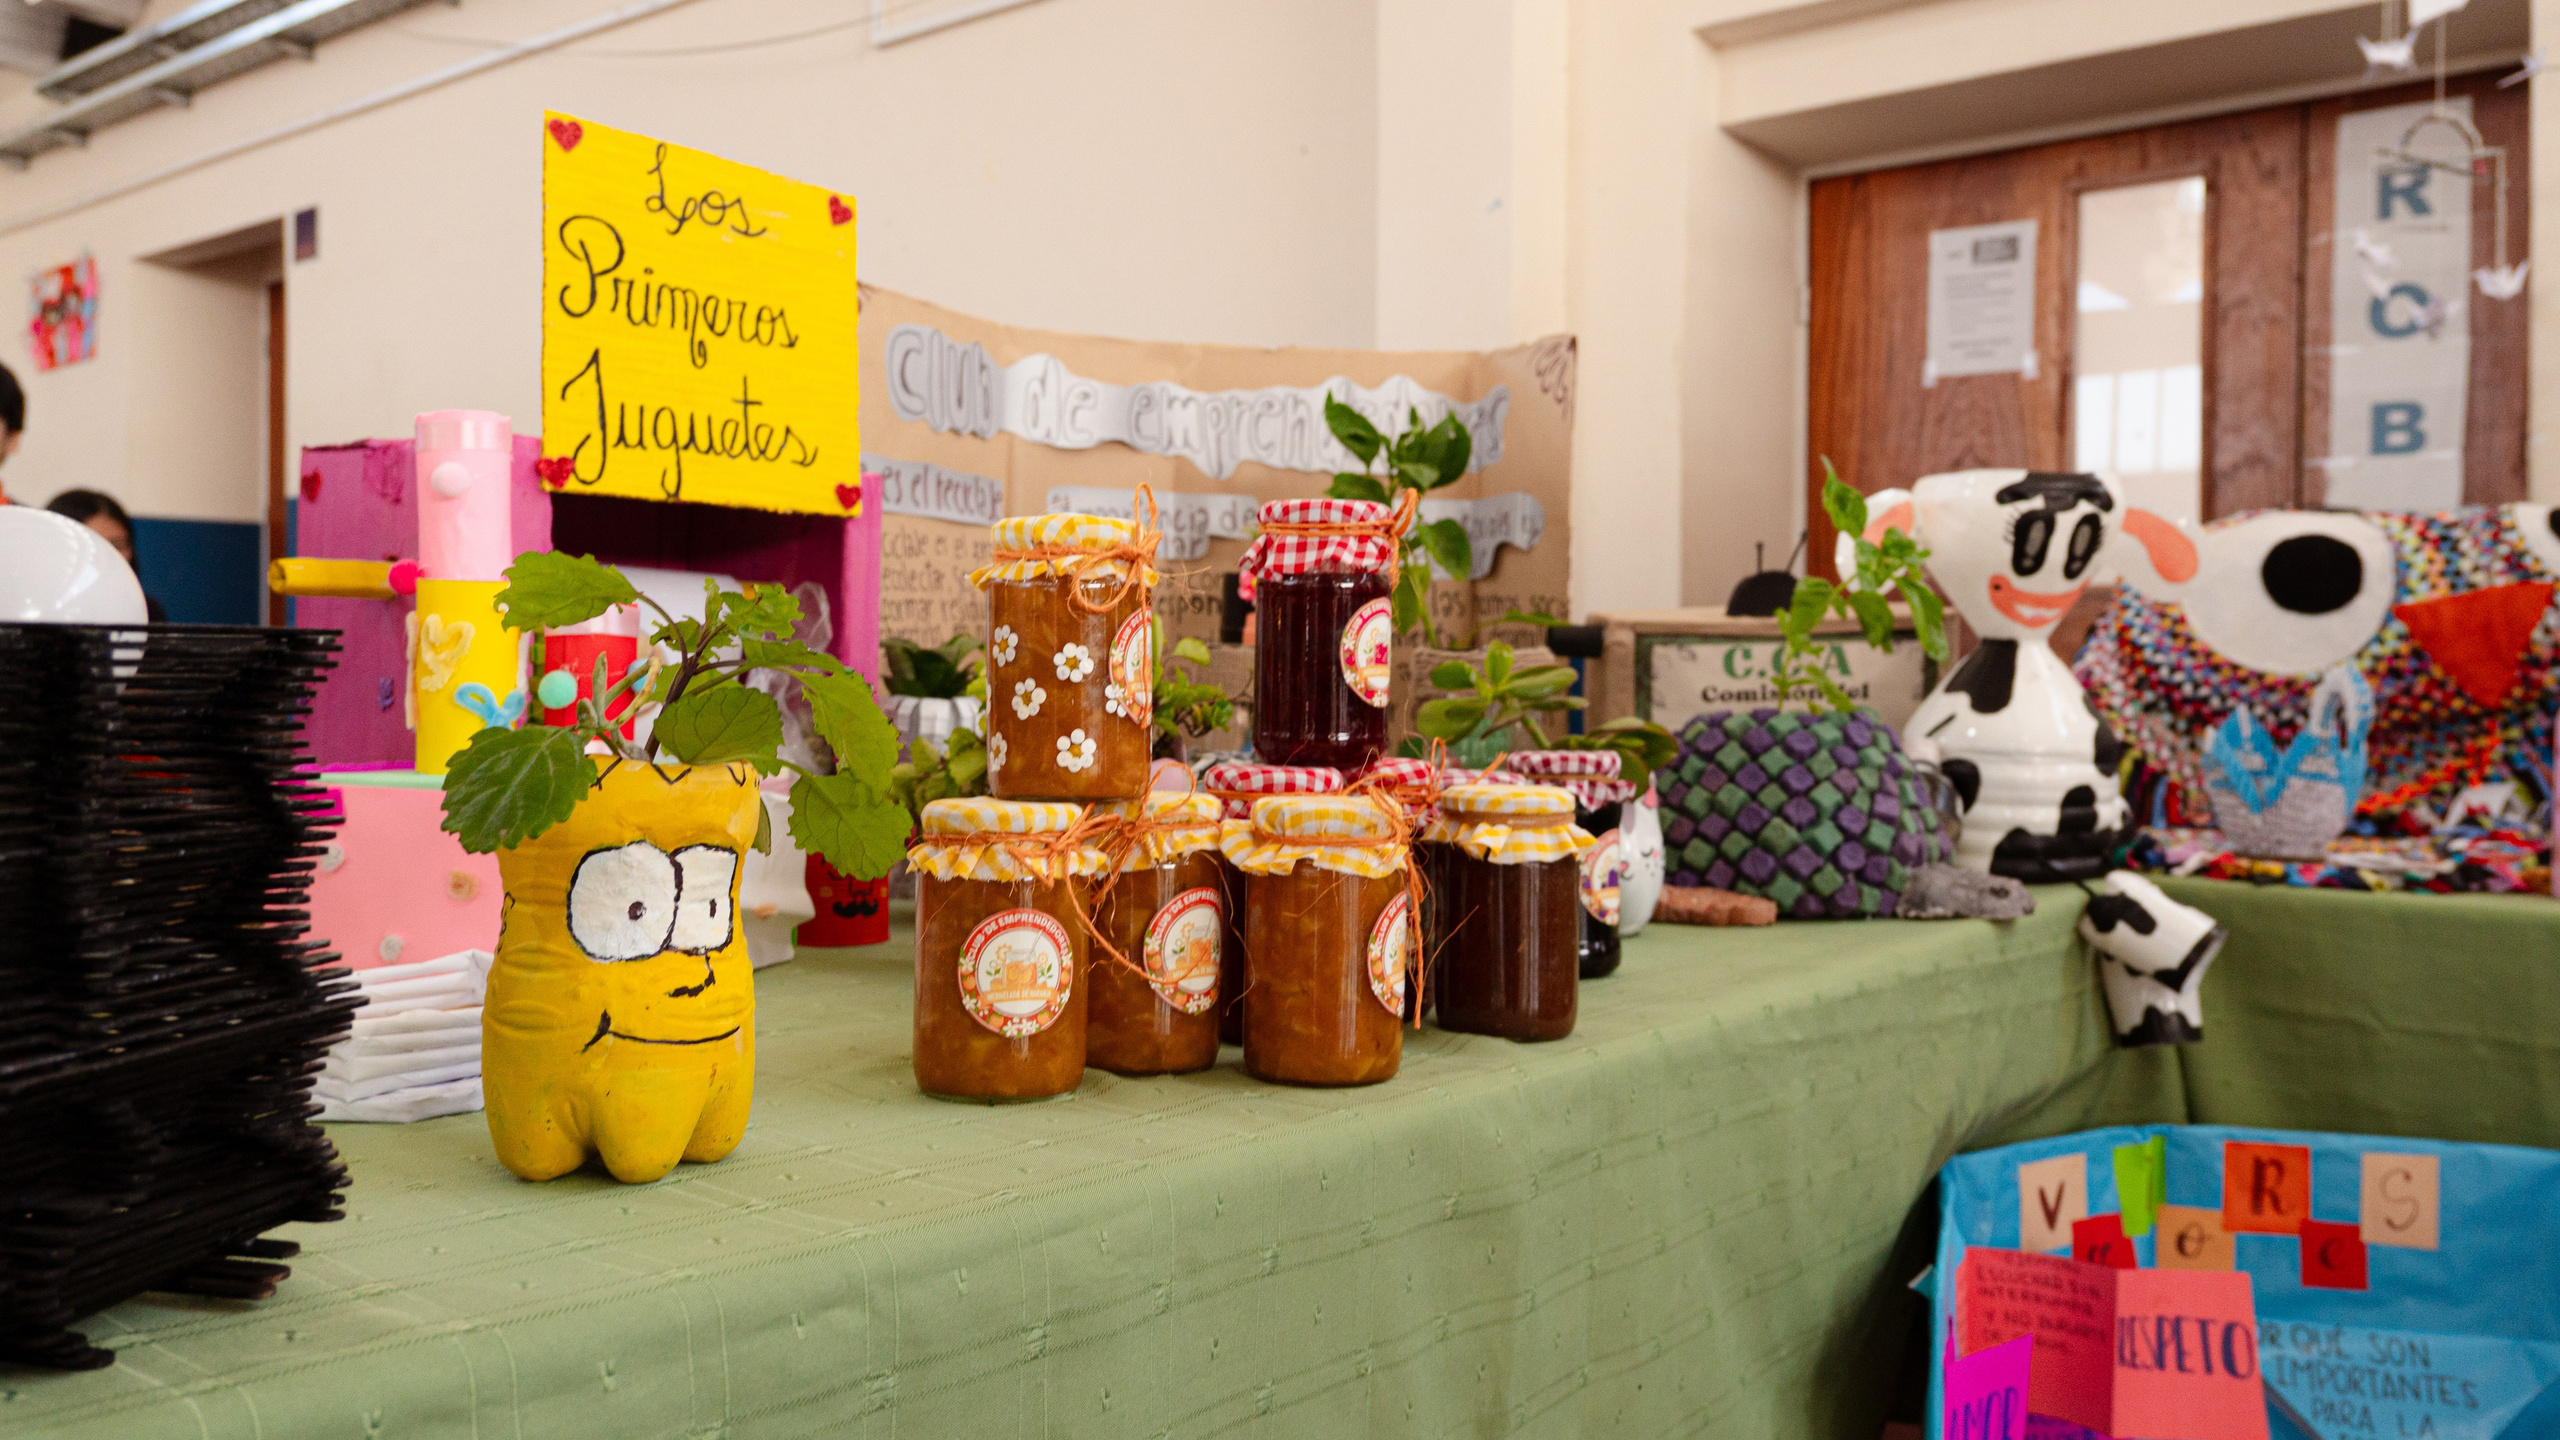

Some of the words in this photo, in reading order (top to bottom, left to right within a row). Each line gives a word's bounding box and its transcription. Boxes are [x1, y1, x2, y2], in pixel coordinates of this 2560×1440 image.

[645, 142, 767, 237] Los
[559, 215, 799, 369] Primeros
[560, 347, 819, 501] Juguetes
[1023, 356, 1100, 448] de
[982, 921, 999, 936] DE
[2276, 1354, 2479, 1409] IMPORTANTES
[2368, 1332, 2431, 1369] SON
[2311, 1400, 2376, 1433] PARA
[2397, 1412, 2436, 1440] LA
